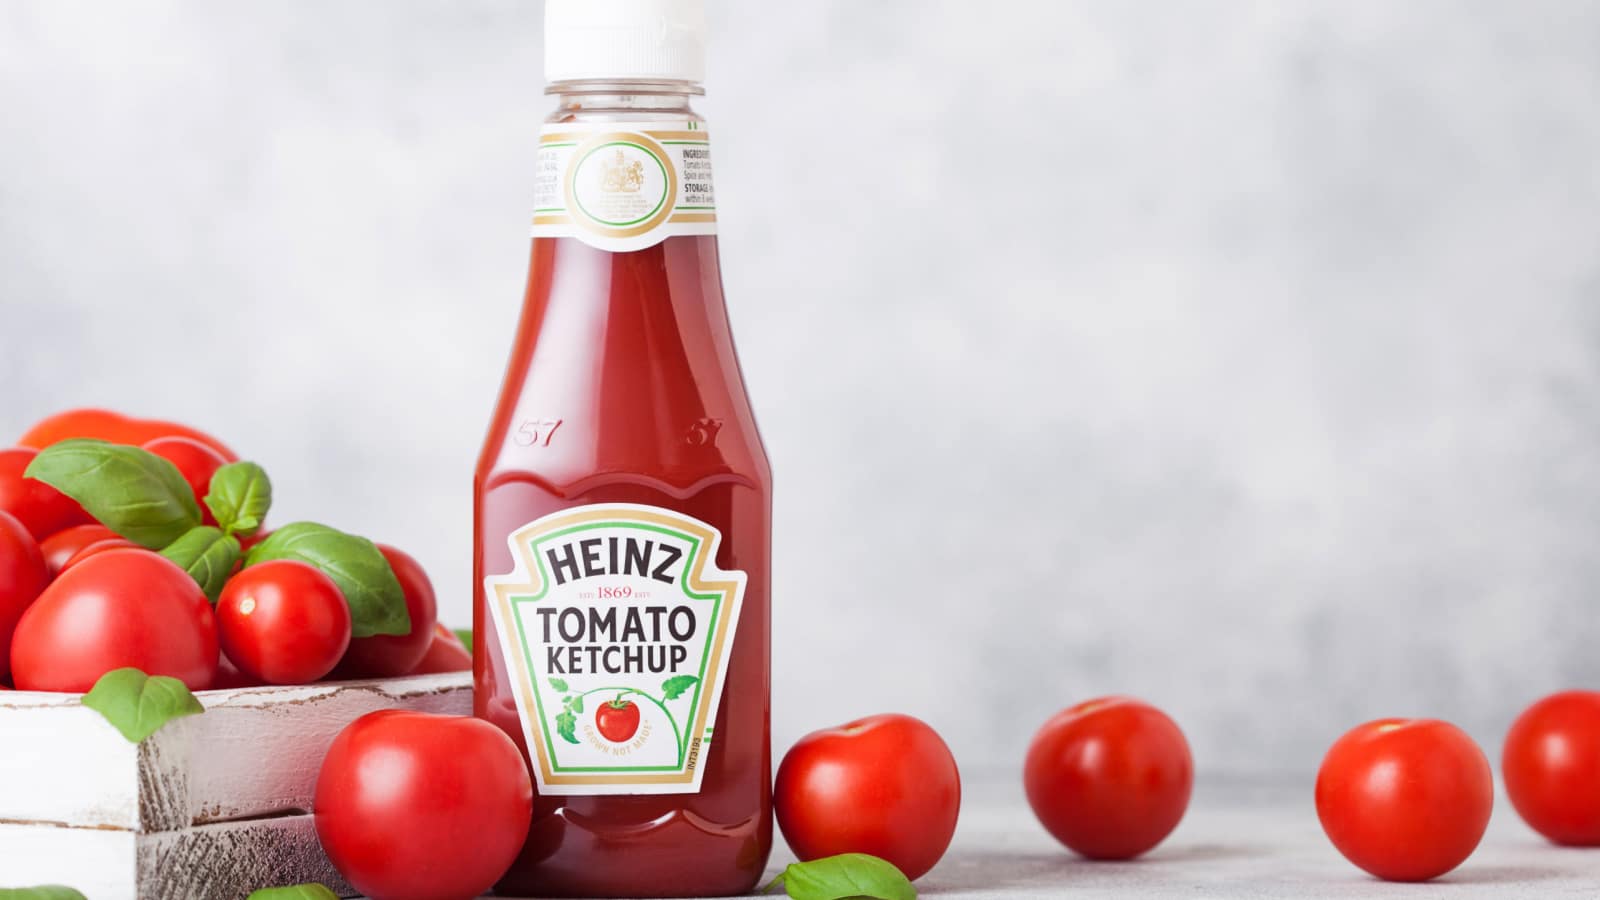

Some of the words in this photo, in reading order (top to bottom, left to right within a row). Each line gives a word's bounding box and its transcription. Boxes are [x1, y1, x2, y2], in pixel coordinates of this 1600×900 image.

[684, 183, 709, 193] STORAGE
[514, 419, 563, 448] 57
[546, 537, 683, 585] HEINZ
[598, 586, 632, 599] 1869
[536, 605, 697, 643] TOMATO
[547, 645, 688, 674] KETCHUP
[583, 724, 610, 753] GROWN
[612, 745, 631, 756] NOT
